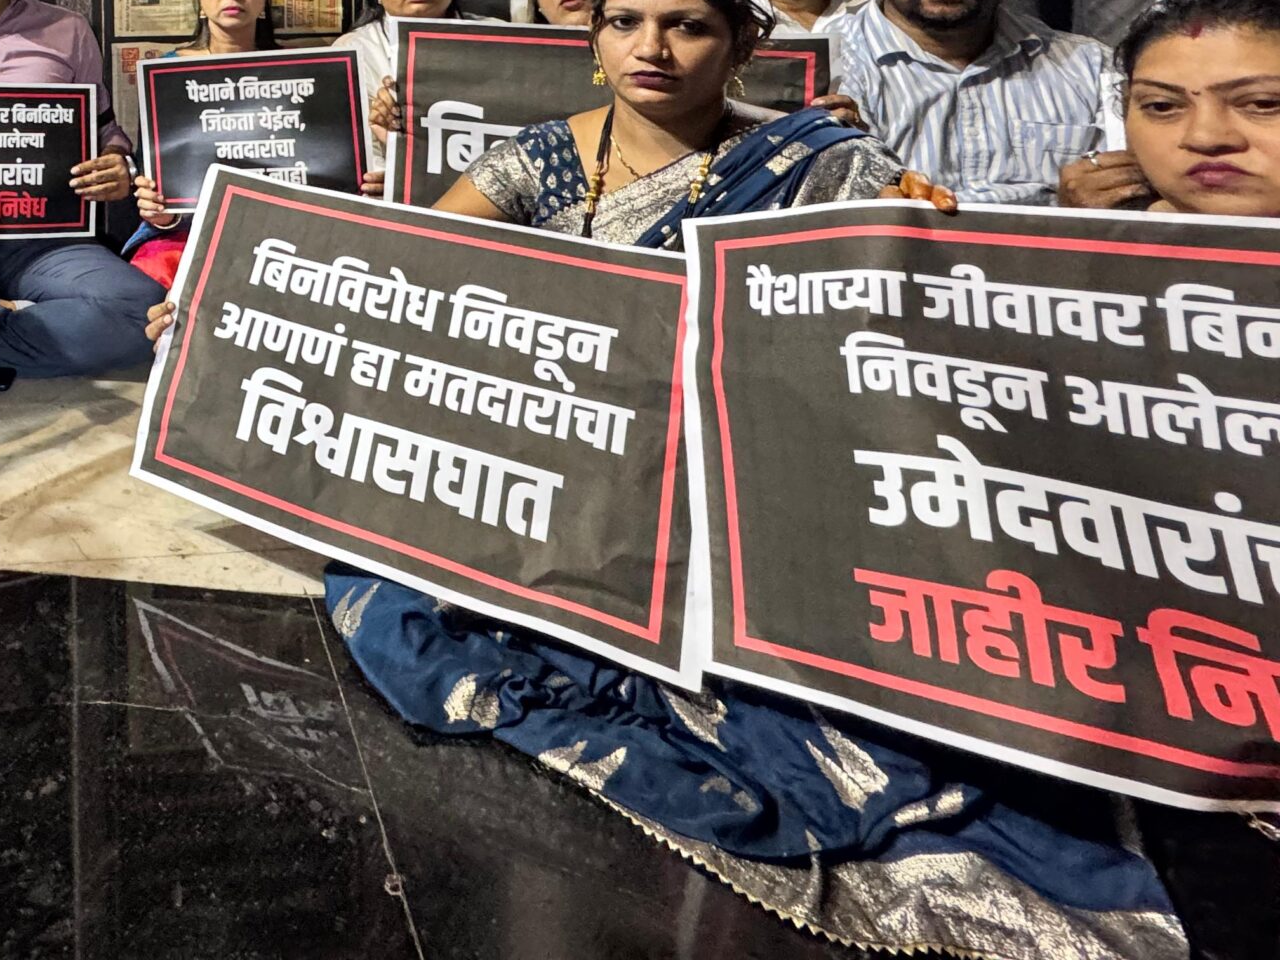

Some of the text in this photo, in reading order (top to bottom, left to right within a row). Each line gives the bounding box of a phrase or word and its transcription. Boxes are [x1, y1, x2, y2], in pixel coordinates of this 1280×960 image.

[11, 103, 74, 124] बिनविरोध
[185, 76, 315, 103] पैशाने निवडणूक
[199, 105, 306, 133] जिंकता येईल,
[215, 134, 296, 160] मतदारांचा
[214, 302, 349, 377] आणणं
[350, 339, 401, 393] हा
[249, 237, 618, 384] बिनविरोध निवडून
[746, 264, 906, 317] पैशाच्या
[912, 264, 1148, 348] जीवावर
[840, 331, 1049, 433] निवडून
[235, 367, 564, 544] विश्वासघात
[853, 569, 1127, 704] जाहीर
